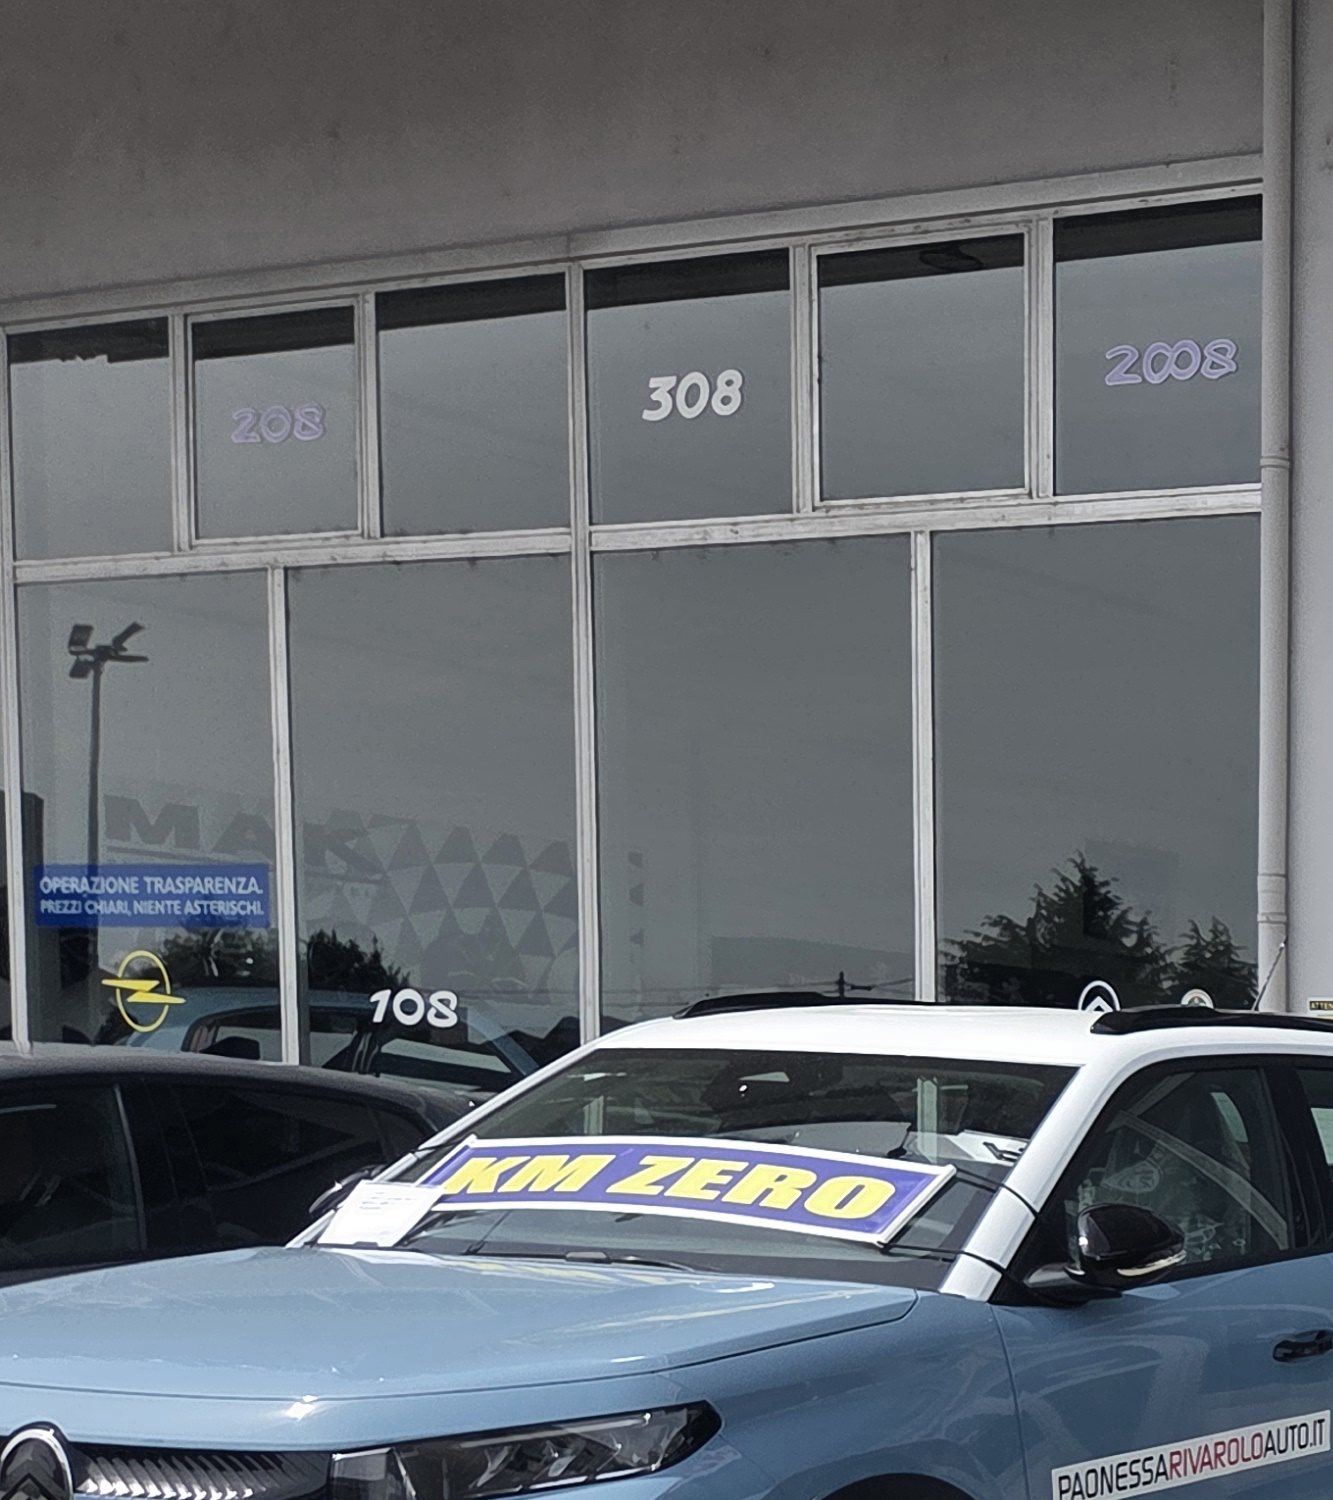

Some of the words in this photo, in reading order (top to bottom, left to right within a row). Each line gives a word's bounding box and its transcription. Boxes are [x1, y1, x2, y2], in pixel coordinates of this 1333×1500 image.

[1105, 338, 1239, 387] 2008
[642, 368, 744, 421] 308
[230, 405, 326, 443] 208
[39, 876, 139, 895] OPERAZIONE
[143, 876, 263, 895] TRASPARENZA.
[40, 900, 82, 914] PREZZI
[134, 901, 182, 915] NIENTE
[370, 989, 458, 1028] 108
[442, 1154, 616, 1195] KM
[607, 1155, 897, 1221] ZERO
